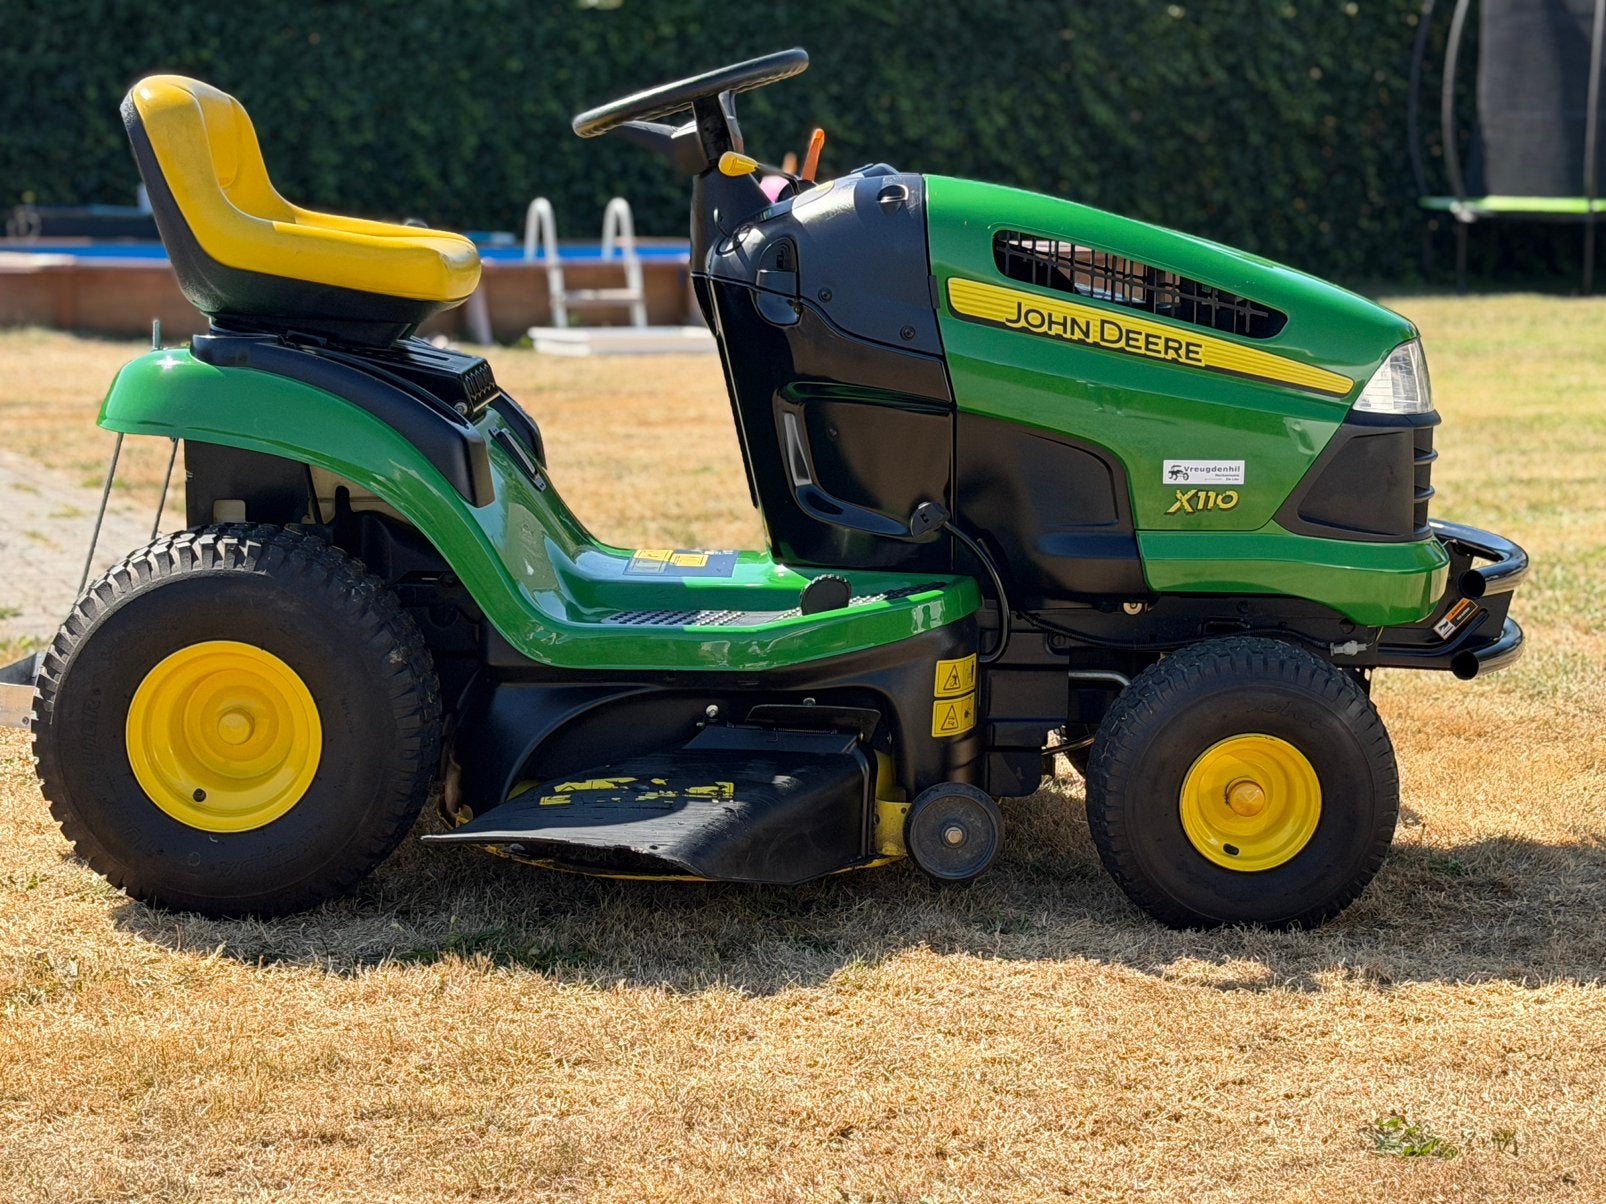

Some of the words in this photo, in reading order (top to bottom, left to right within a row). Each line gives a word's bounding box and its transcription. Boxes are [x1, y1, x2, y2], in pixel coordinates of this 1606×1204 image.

[1005, 301, 1091, 340] JOHN
[1099, 318, 1203, 363] DEERE
[1183, 465, 1241, 474] Vreugdenhil
[1165, 488, 1240, 514] X110
